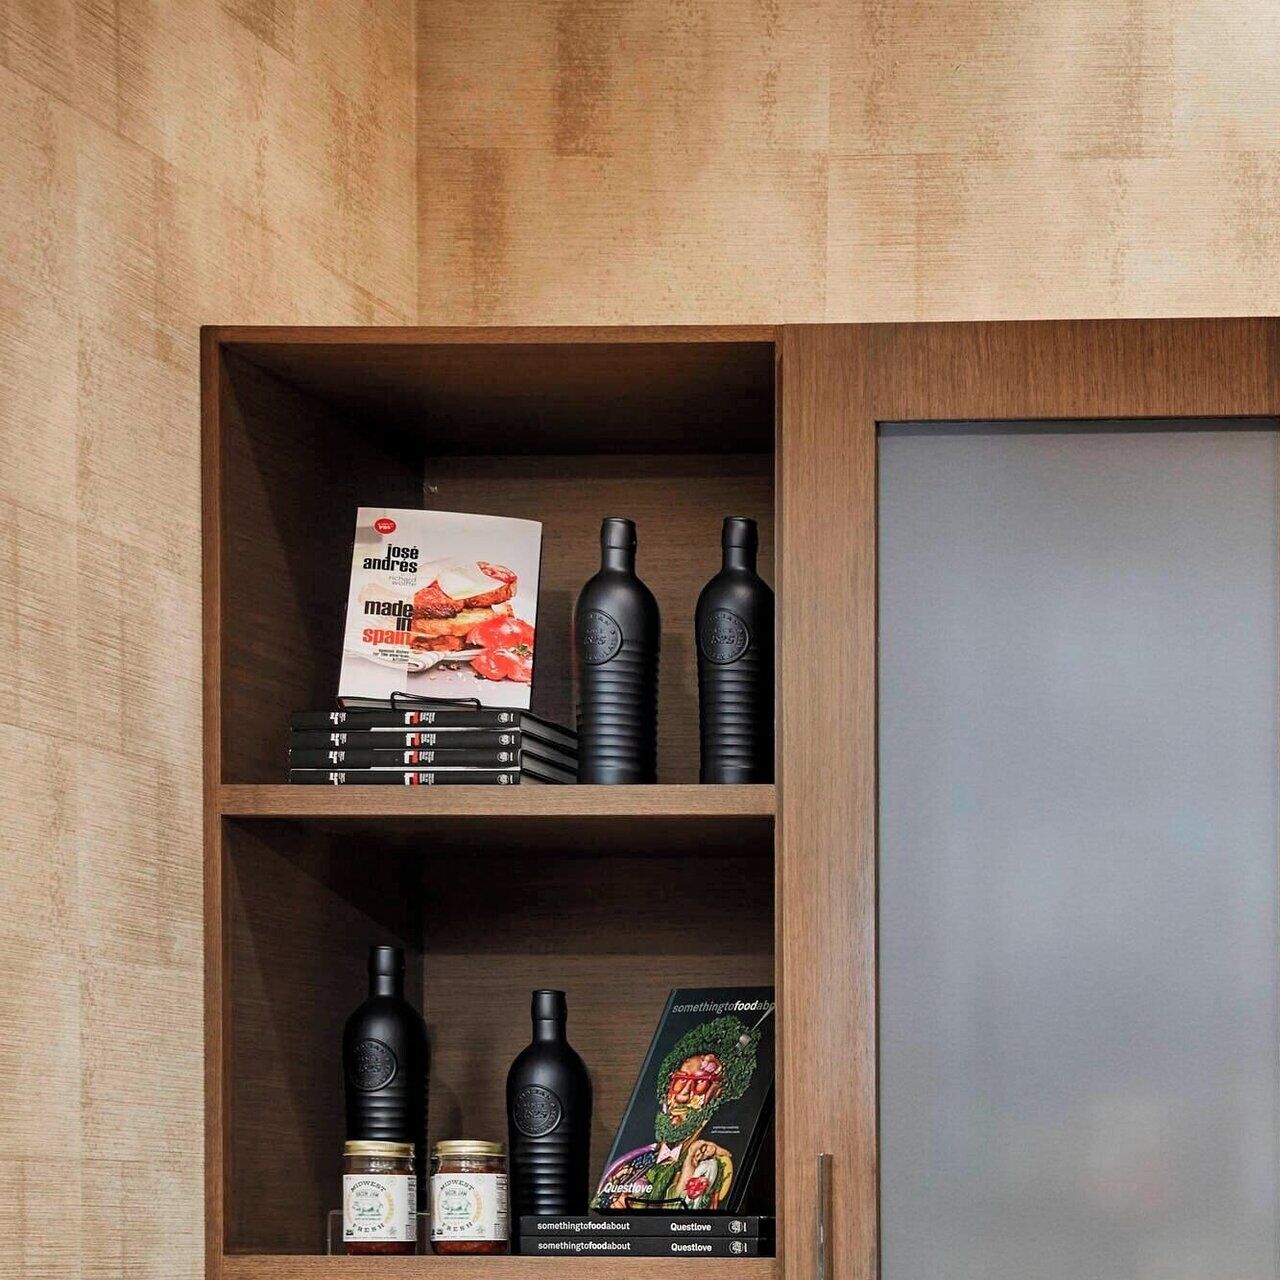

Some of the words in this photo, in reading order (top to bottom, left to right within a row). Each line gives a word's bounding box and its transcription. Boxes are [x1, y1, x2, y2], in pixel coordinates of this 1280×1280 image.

[385, 544, 419, 559] josé
[363, 558, 418, 573] andrés
[364, 600, 413, 617] made
[396, 618, 412, 631] in
[363, 629, 411, 645] spain
[351, 1181, 386, 1191] MIDWEST
[440, 1180, 474, 1190] MIDWEST
[604, 1182, 653, 1193] Questlove
[352, 1223, 385, 1233] FRESH
[537, 1222, 630, 1232] somethingtofoodabout
[671, 1223, 711, 1232] Questlove
[538, 1242, 630, 1252] somethingtofoodabout
[671, 1243, 712, 1252] Questlove
